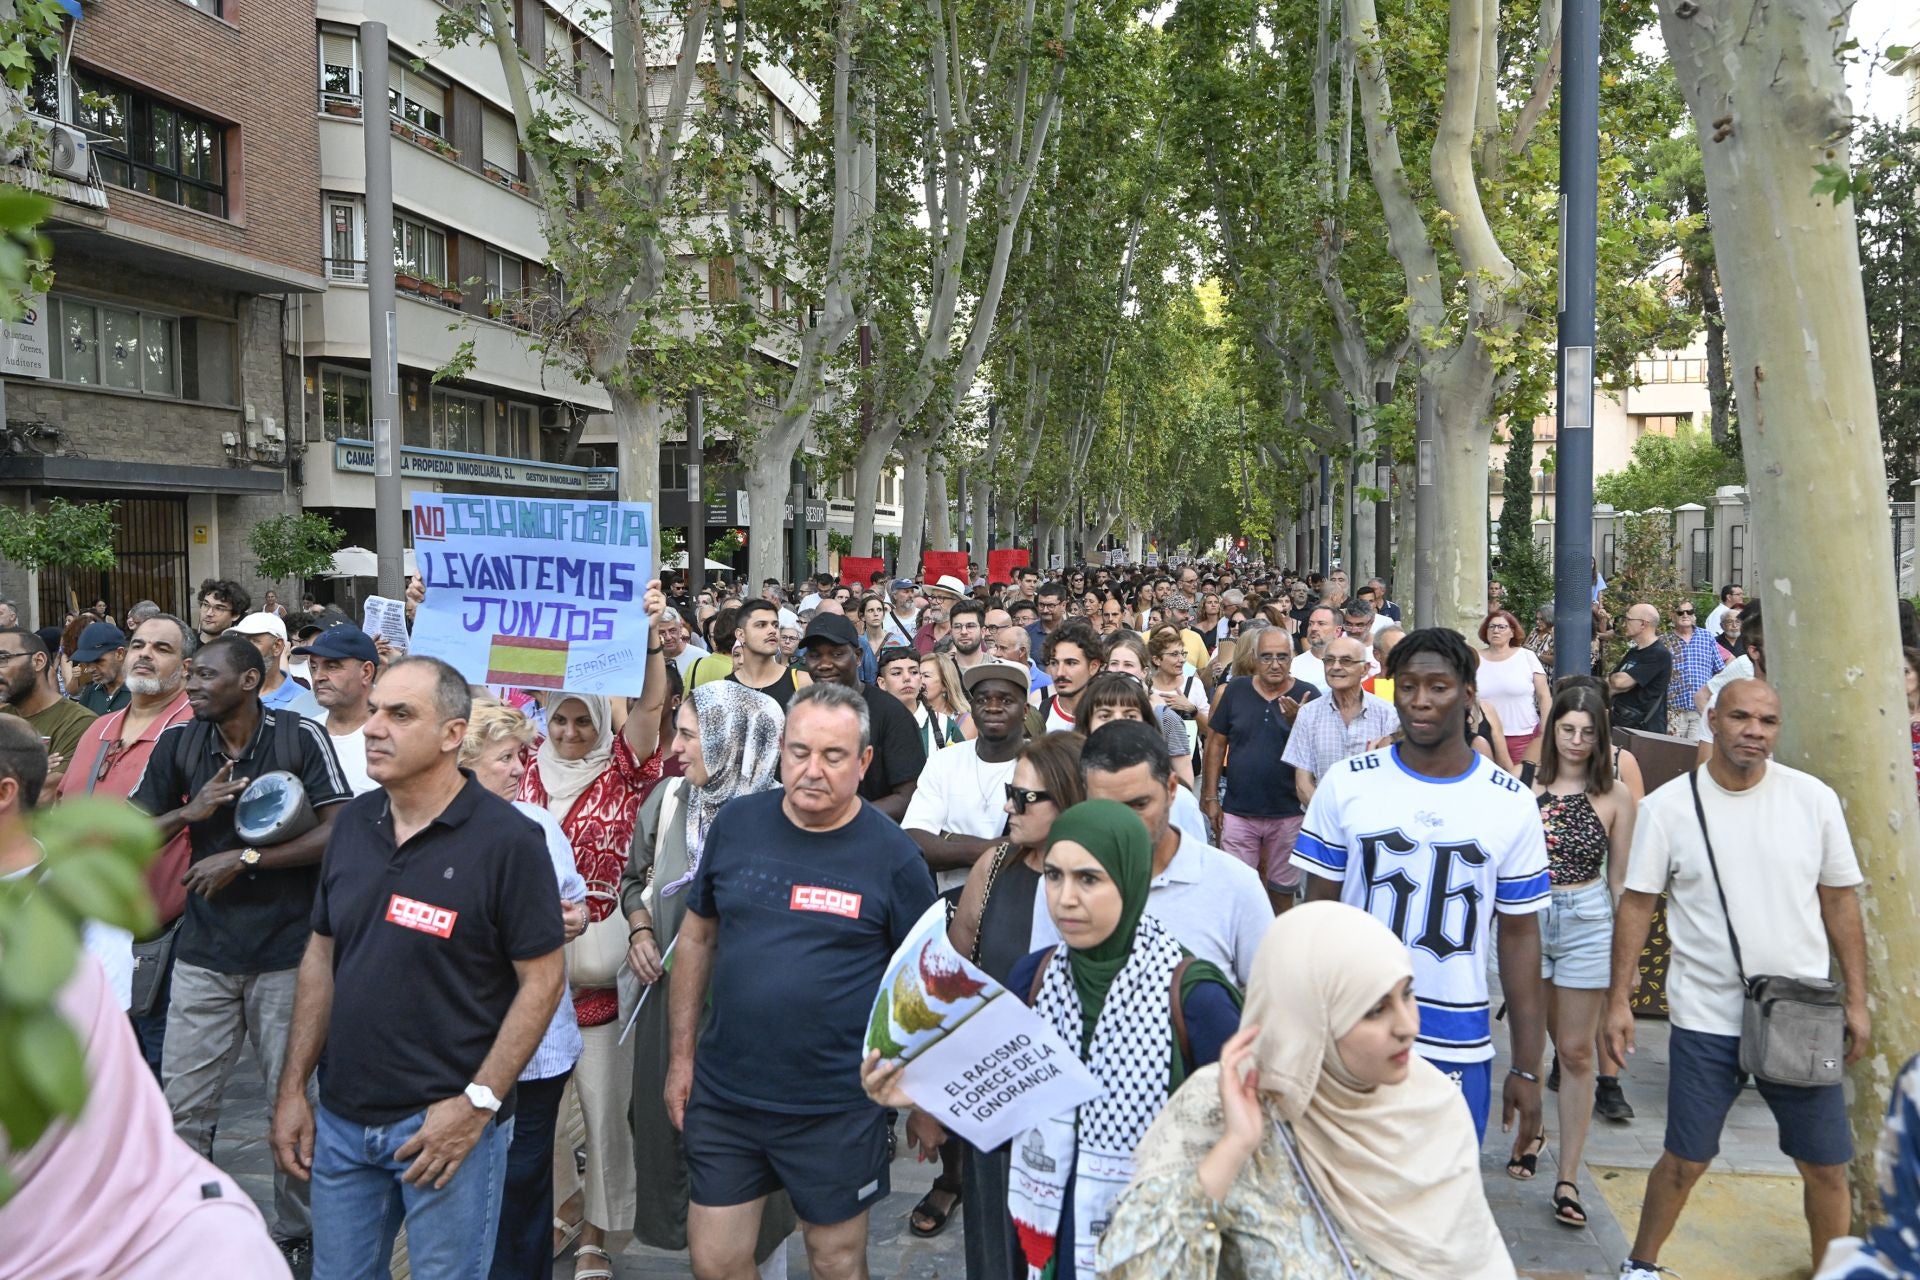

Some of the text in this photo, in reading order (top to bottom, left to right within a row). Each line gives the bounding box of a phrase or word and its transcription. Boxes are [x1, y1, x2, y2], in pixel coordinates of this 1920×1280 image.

[5, 356, 42, 368] Auditores
[412, 458, 454, 474] PROPIEDAD
[456, 462, 503, 480] INMOBILIARIA,
[504, 467, 516, 480] S.L.
[525, 472, 582, 486] GESTION INMOBILIARIA
[414, 504, 446, 537] NO
[424, 551, 636, 602] LEVANTEMOS
[462, 596, 618, 641] JUNTOS
[1349, 754, 1380, 773] 66
[1489, 769, 1520, 793] 66
[795, 887, 857, 911] CCOO
[1357, 827, 1491, 963] 66
[944, 1034, 1031, 1097] EL RACISMO
[949, 1043, 1056, 1117] FLORECE DE LA
[972, 1062, 1063, 1122] IGNORANCIA
